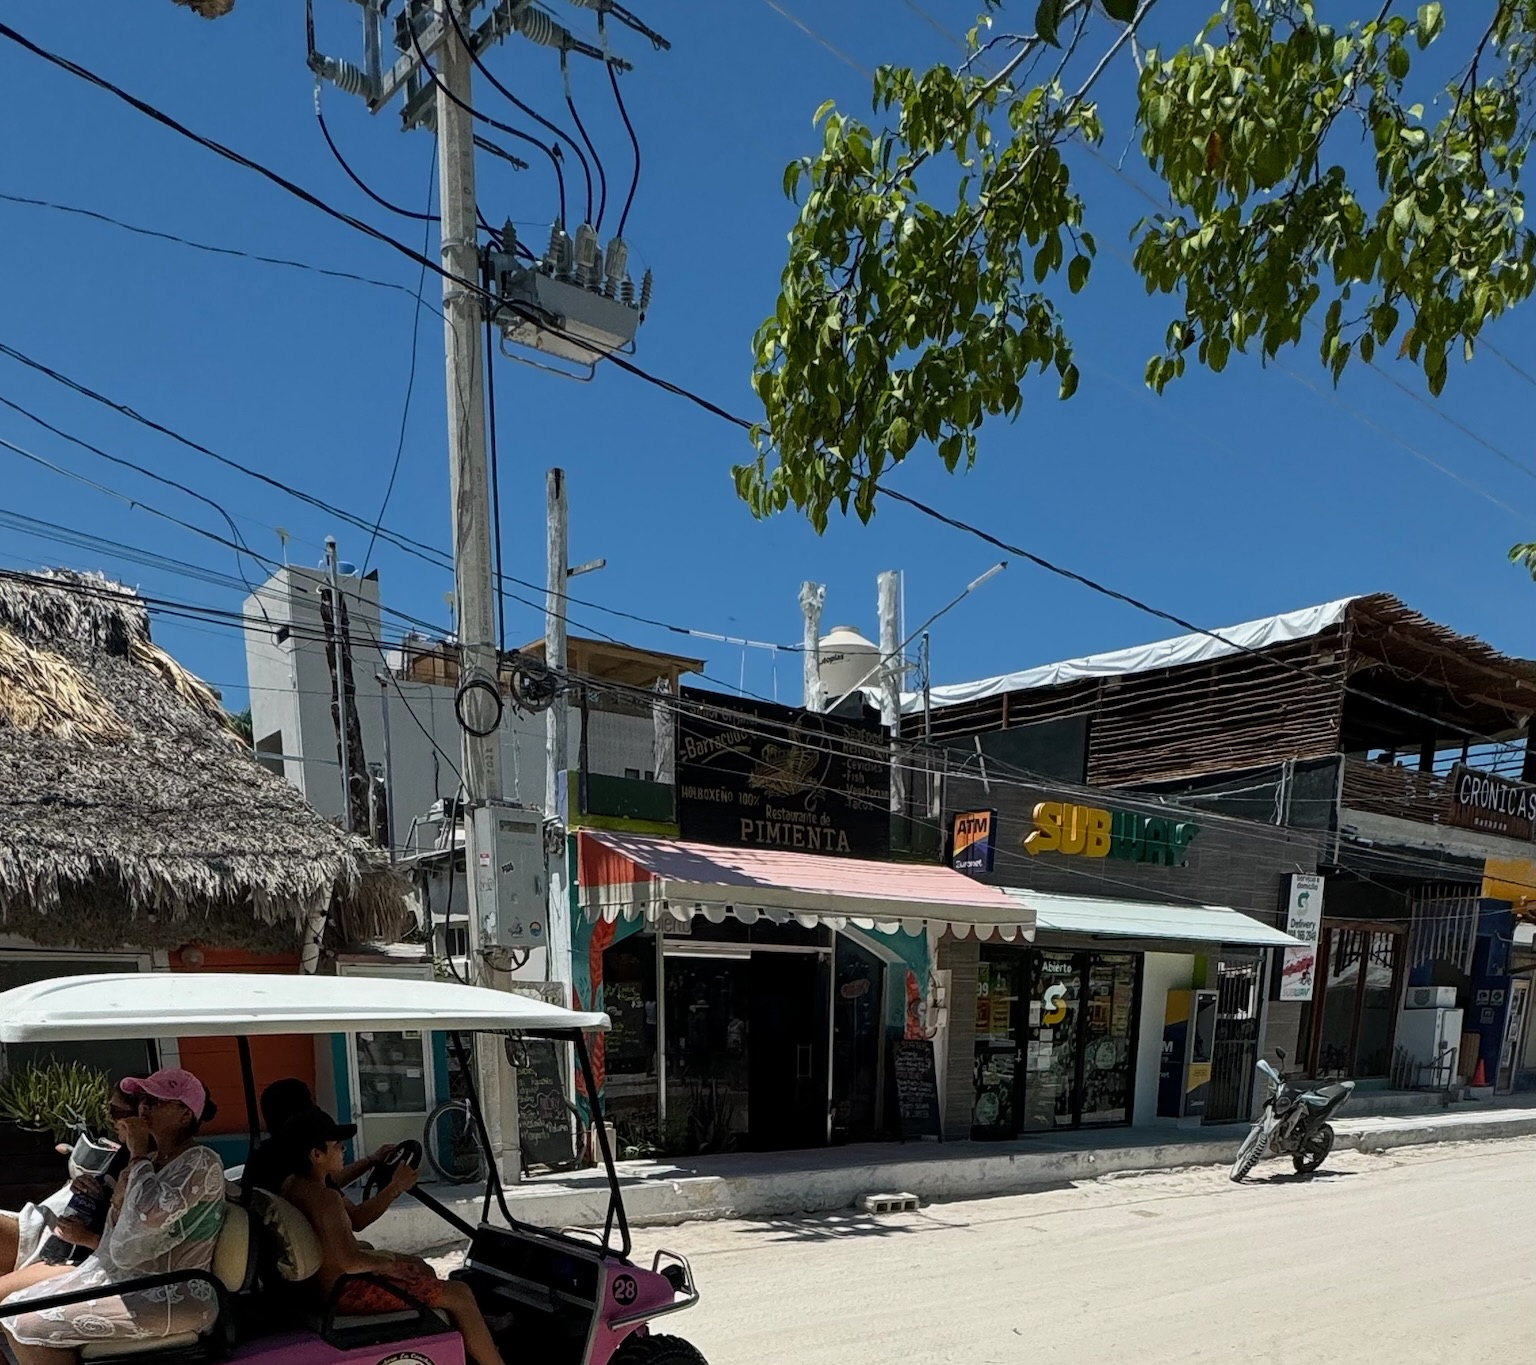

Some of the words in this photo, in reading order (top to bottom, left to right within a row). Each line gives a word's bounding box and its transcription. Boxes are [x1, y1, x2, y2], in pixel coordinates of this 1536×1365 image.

[843, 724, 884, 745] Seafood
[681, 784, 733, 802] HOLBOXEÑO
[739, 791, 760, 807] 100%
[765, 805, 817, 826] Restaurante
[819, 814, 831, 826] de
[740, 818, 850, 851] PIMIENTA
[957, 817, 987, 836] ATM
[1024, 802, 1199, 866] SUBWAY
[1290, 918, 1316, 931] Delivery
[1041, 961, 1073, 974] Abierto
[613, 1280, 636, 1300] 28
